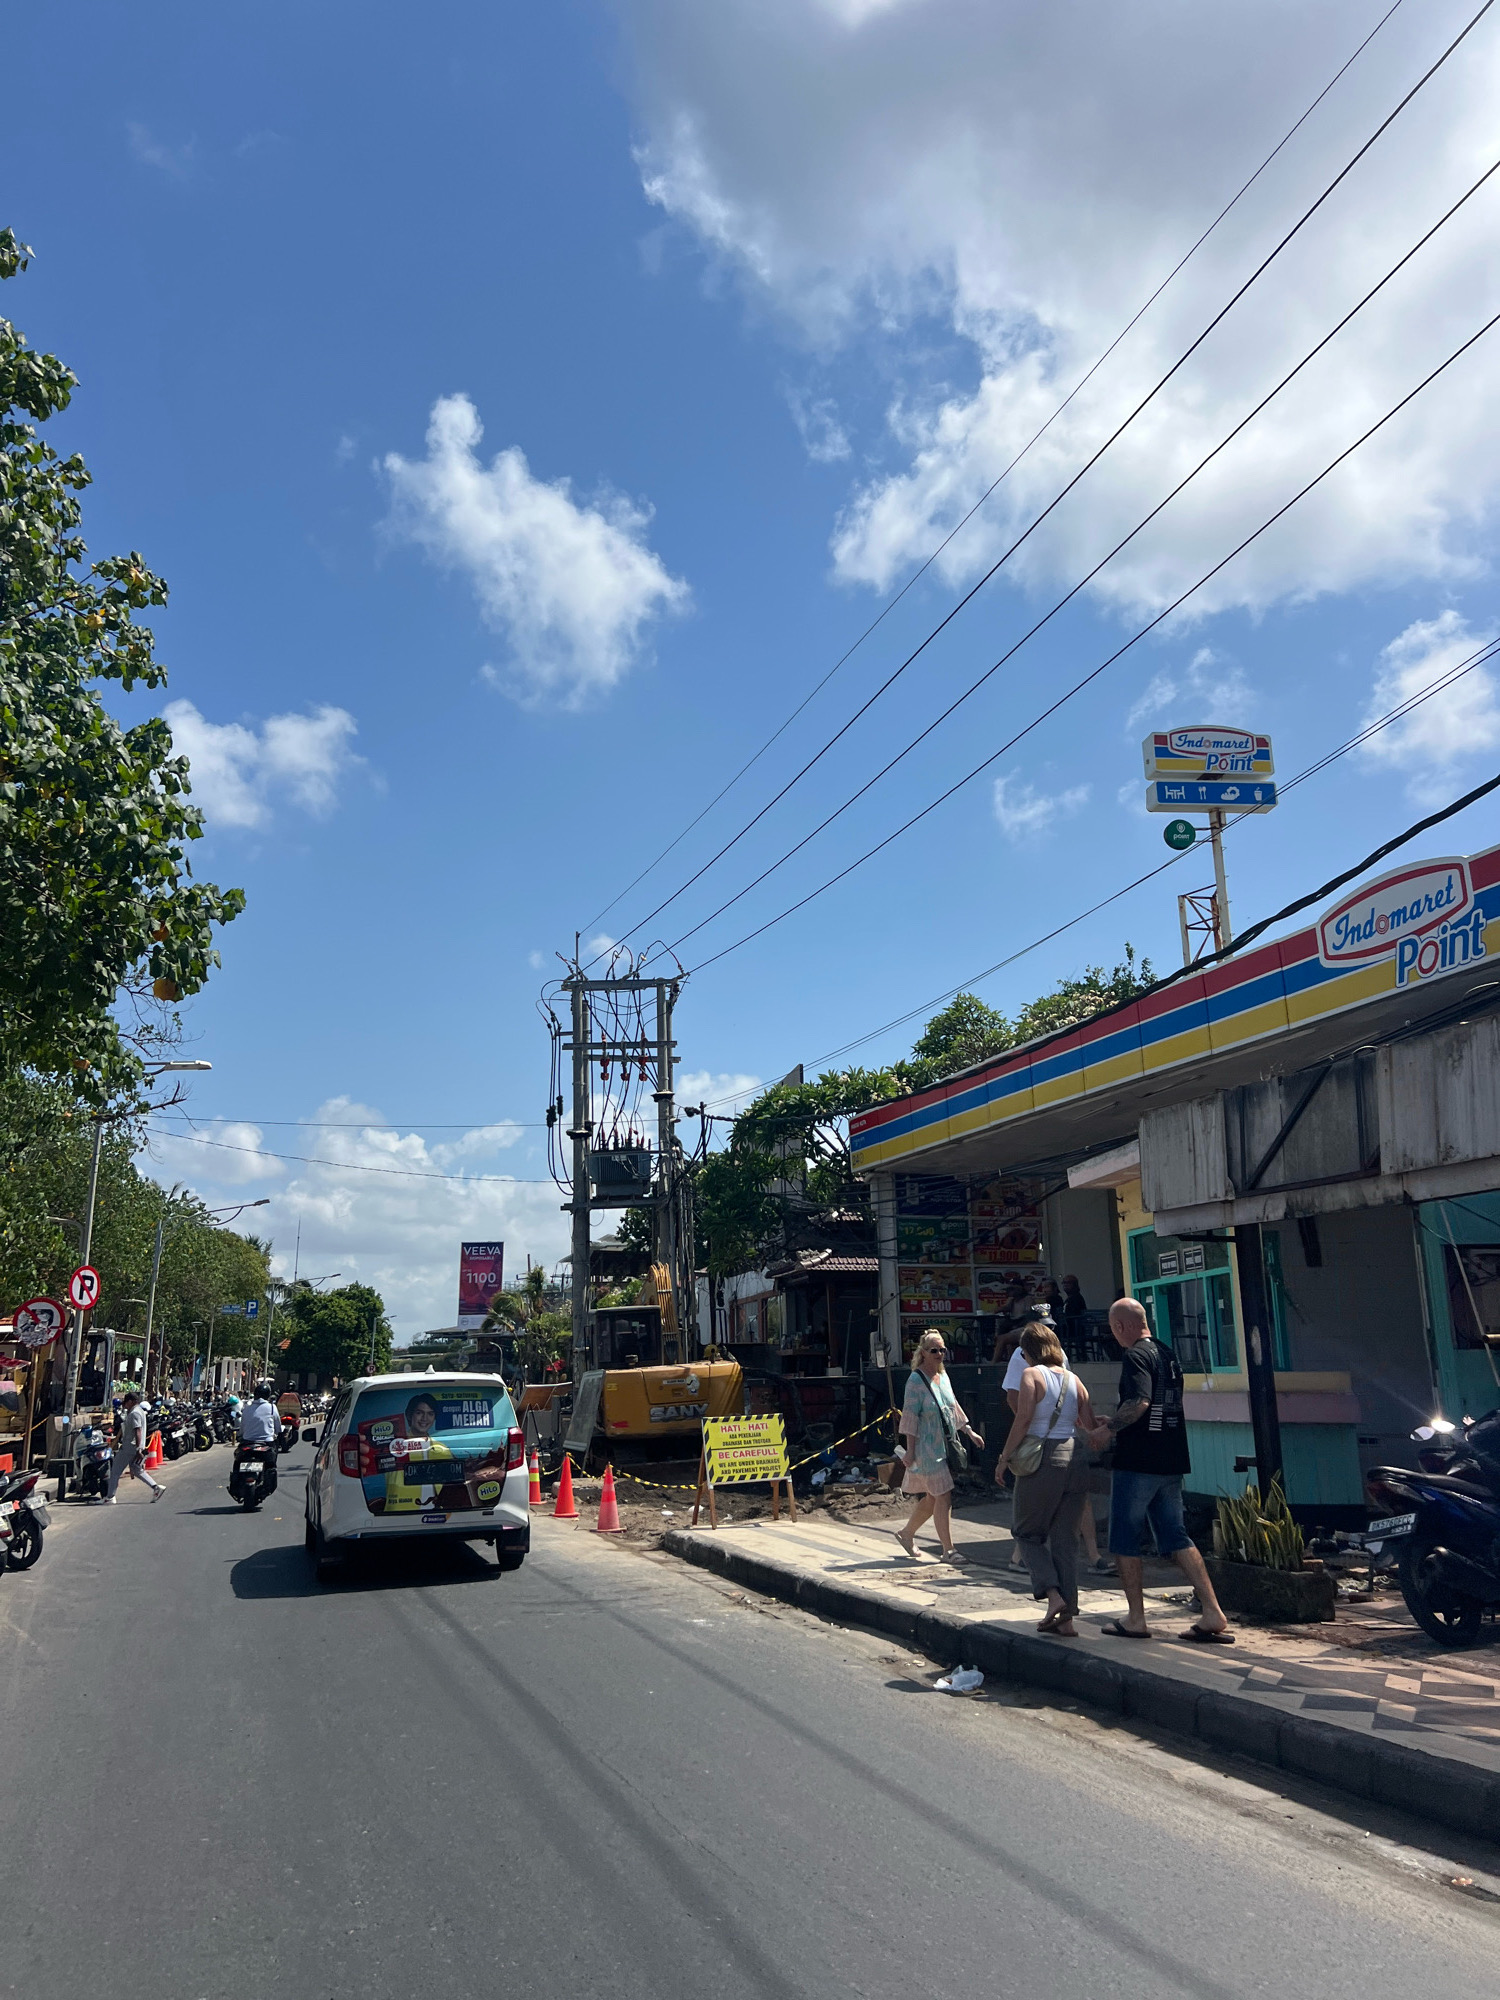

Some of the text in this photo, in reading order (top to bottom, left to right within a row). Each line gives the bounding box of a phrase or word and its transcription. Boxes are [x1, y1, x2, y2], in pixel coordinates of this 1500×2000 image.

[1175, 733, 1251, 750] Indomaret
[1206, 753, 1254, 772] Point
[1332, 874, 1456, 951] Indomaret
[1398, 912, 1486, 985] Point
[463, 1246, 501, 1256] VEEVA
[466, 1272, 497, 1284] 1100
[79, 1275, 94, 1300] P
[248, 1301, 257, 1313] P
[922, 1299, 952, 1311] 5.500
[462, 1400, 489, 1413] ALGA
[650, 1403, 709, 1422] SANY
[452, 1413, 490, 1426] MERAH
[1149, 1403, 1163, 1431] VIRTUAL
[720, 1424, 741, 1433] HATI
[748, 1423, 769, 1431] HATI
[718, 1447, 779, 1459] BE CAREFULL
[480, 1485, 498, 1496] HiLo
